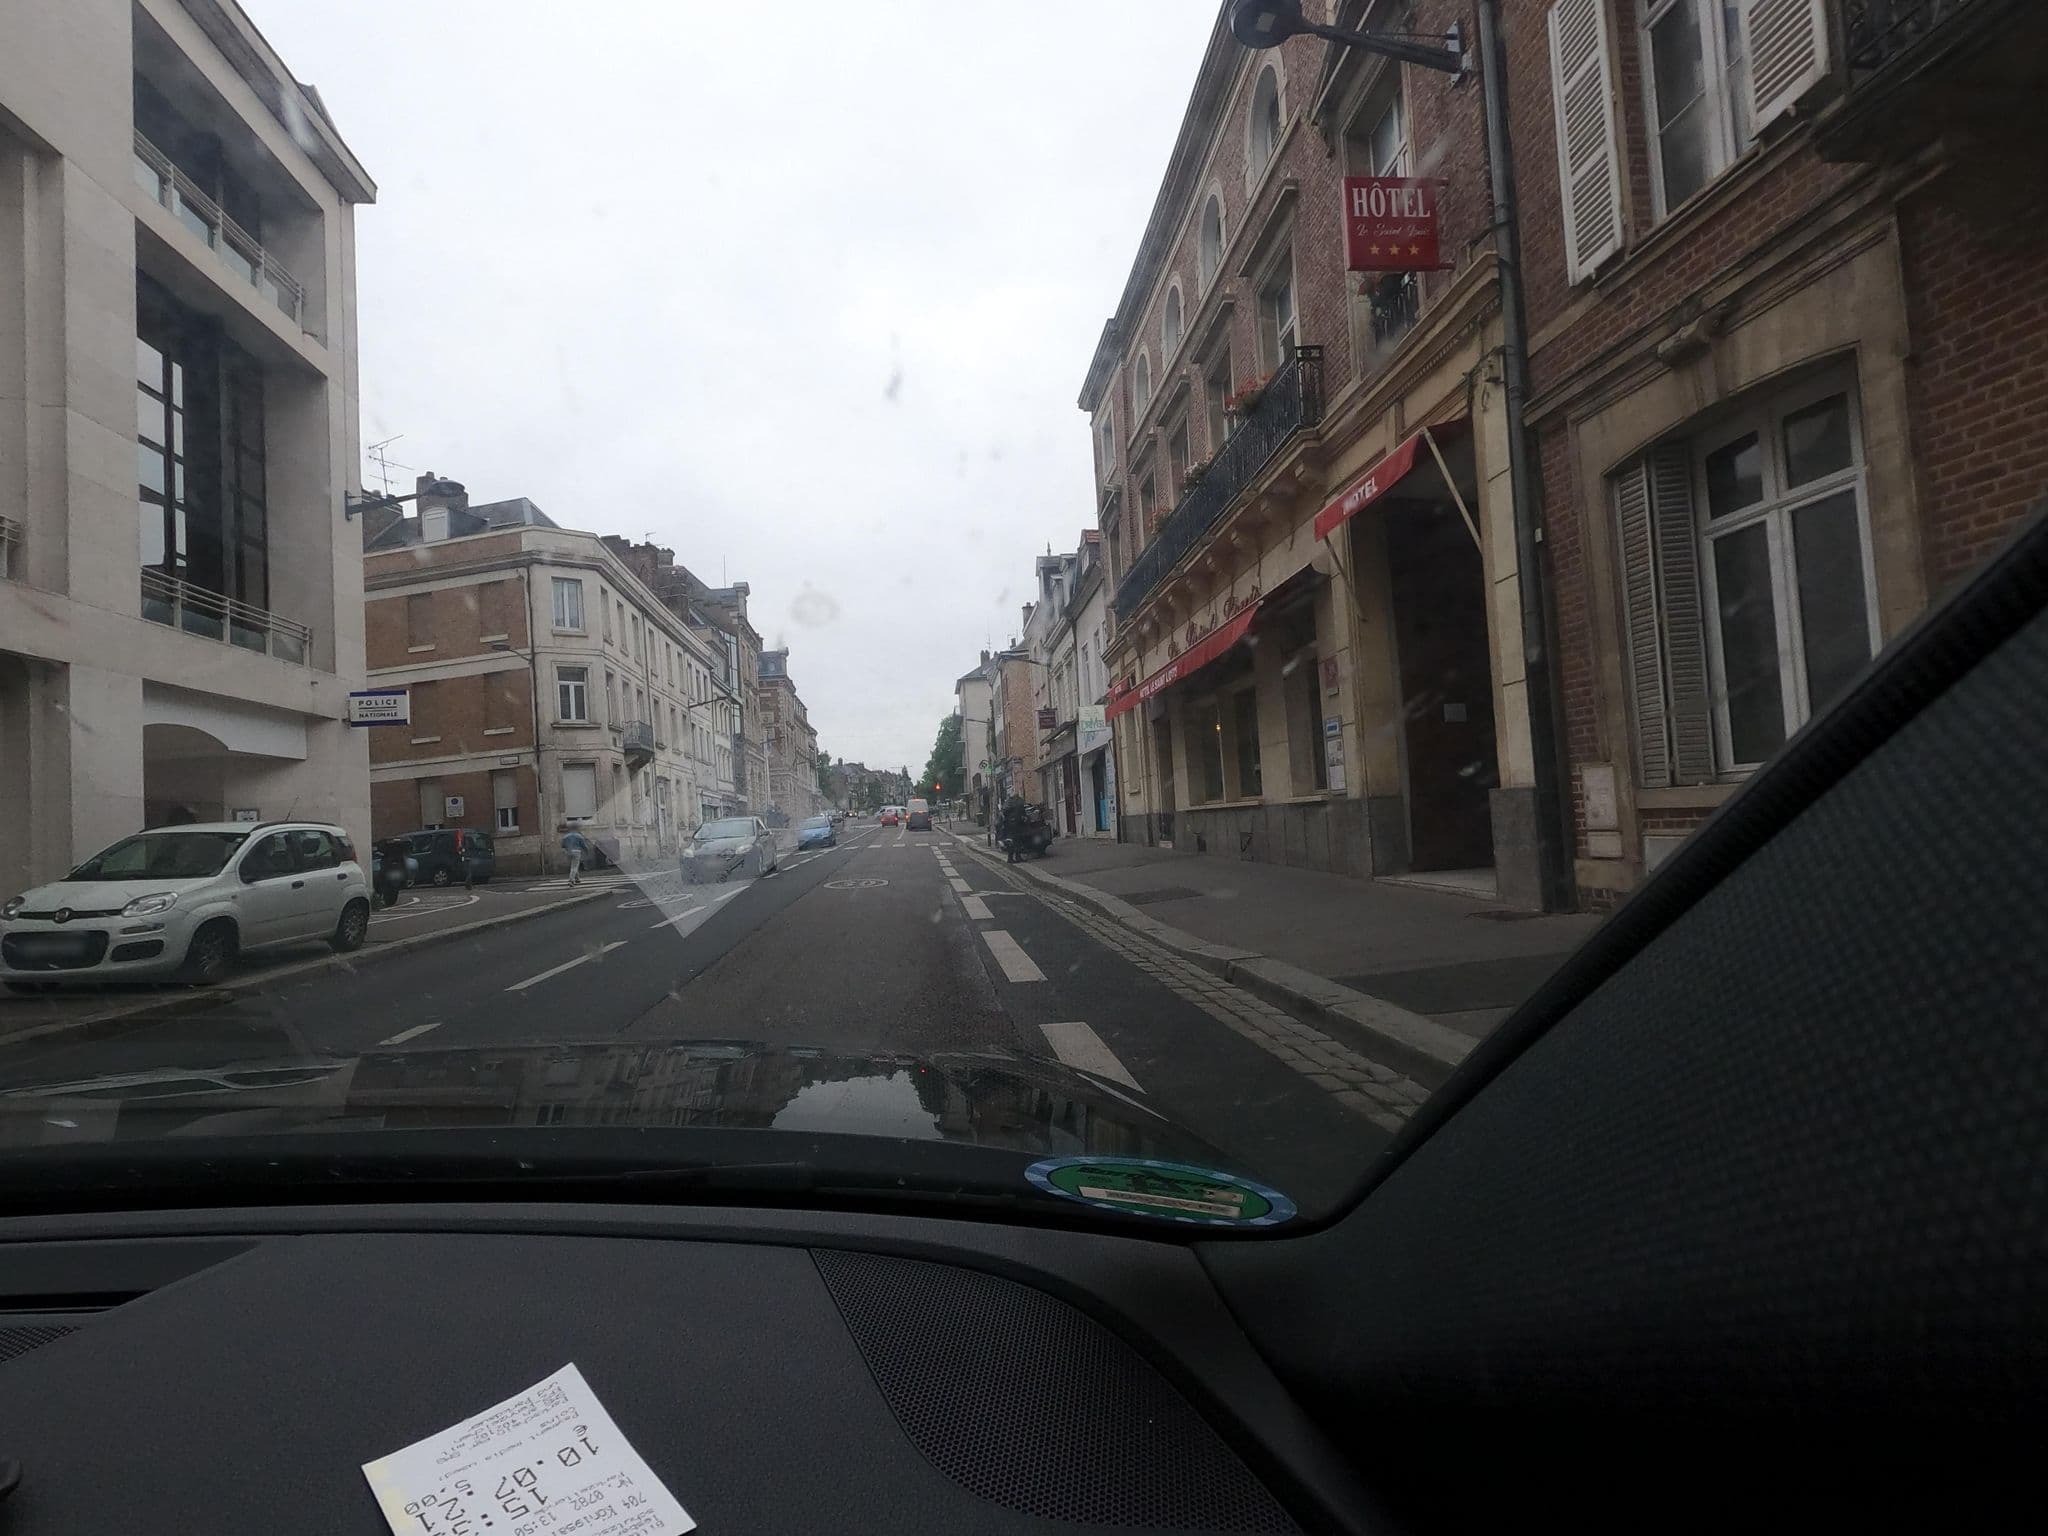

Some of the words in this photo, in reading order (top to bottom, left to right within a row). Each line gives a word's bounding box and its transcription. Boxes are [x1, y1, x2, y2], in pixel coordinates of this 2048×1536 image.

[1352, 182, 1431, 217] HÔTEL
[359, 711, 397, 719] NATIONALE
[572, 1425, 587, 1436] €
[569, 1489, 604, 1511] 0782
